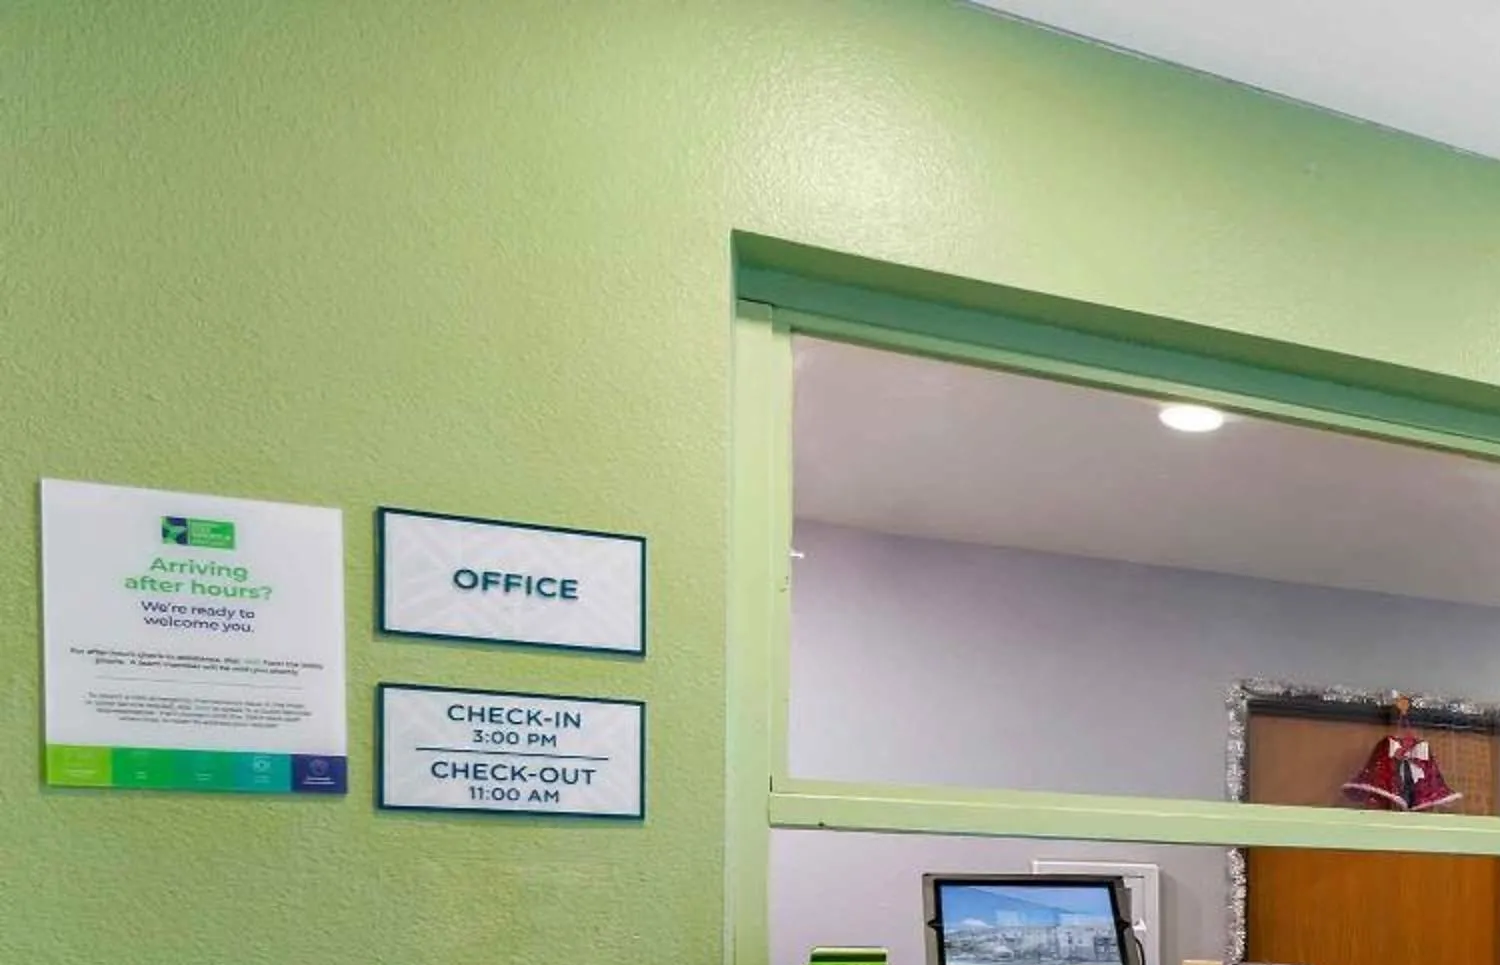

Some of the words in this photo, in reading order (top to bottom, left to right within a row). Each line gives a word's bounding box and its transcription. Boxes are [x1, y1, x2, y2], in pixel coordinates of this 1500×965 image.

[150, 557, 248, 583] Arriving
[124, 575, 185, 593] after
[191, 580, 273, 600] hours?
[453, 568, 579, 600] OFFICE
[141, 601, 187, 615] We're
[192, 605, 235, 619] ready
[239, 608, 255, 619] to
[144, 616, 219, 631] welcome
[222, 622, 255, 633] you.
[447, 704, 582, 729] CHECK-IN
[472, 729, 520, 746] 3:00
[527, 732, 557, 748] PM
[430, 761, 597, 786] CHECK-OUT
[469, 786, 520, 802] 11:00
[527, 788, 560, 803] AM
